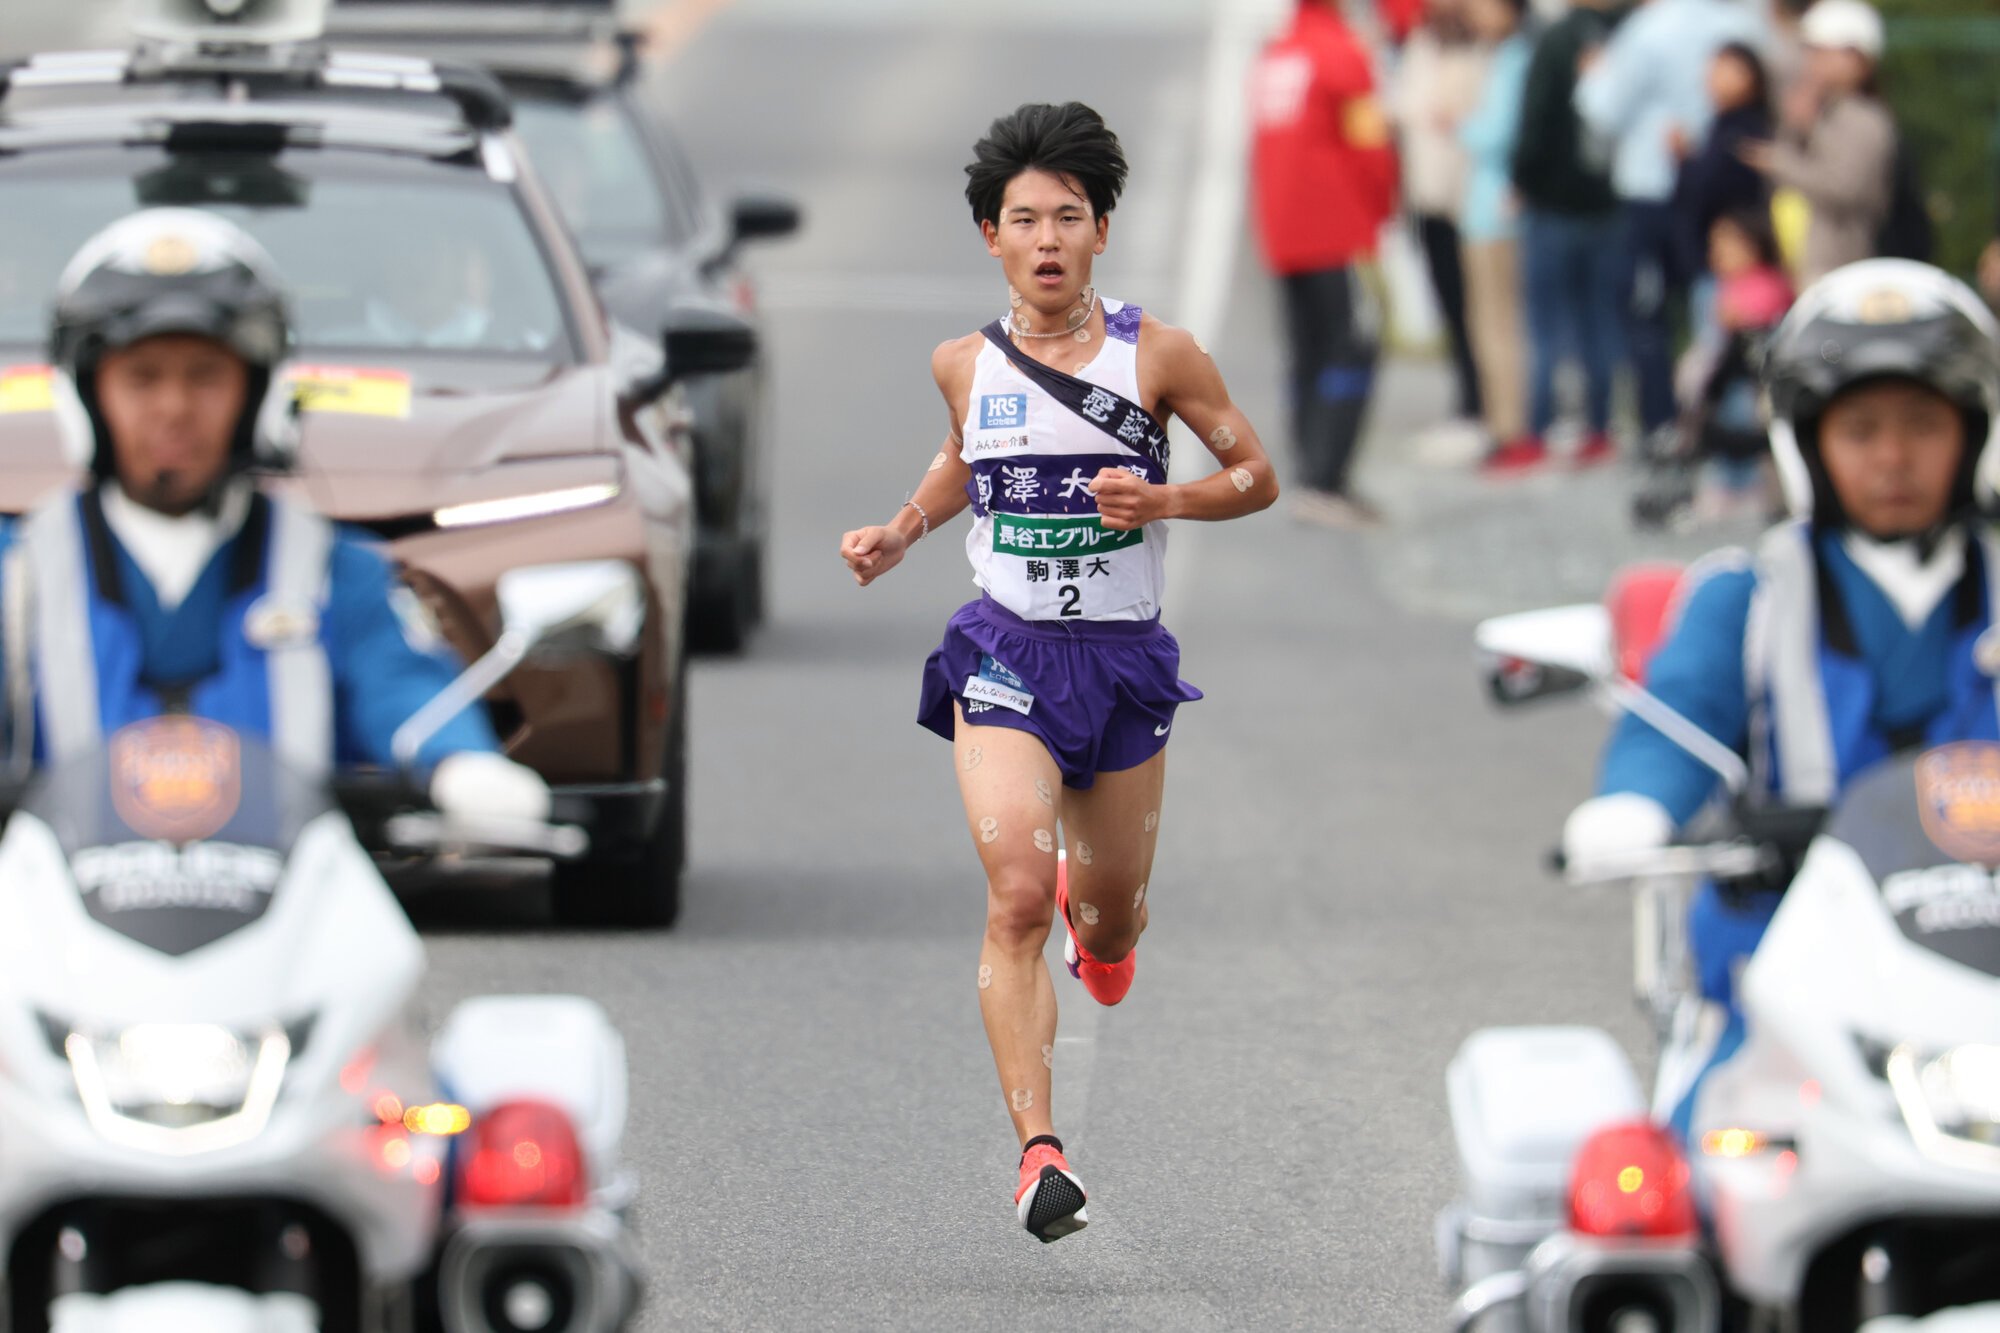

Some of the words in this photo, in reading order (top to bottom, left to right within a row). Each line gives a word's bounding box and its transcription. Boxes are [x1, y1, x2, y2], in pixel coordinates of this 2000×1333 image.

[988, 397, 1018, 417] HRS
[1026, 557, 1110, 582] 駒澤大
[1058, 584, 1082, 617] 2
